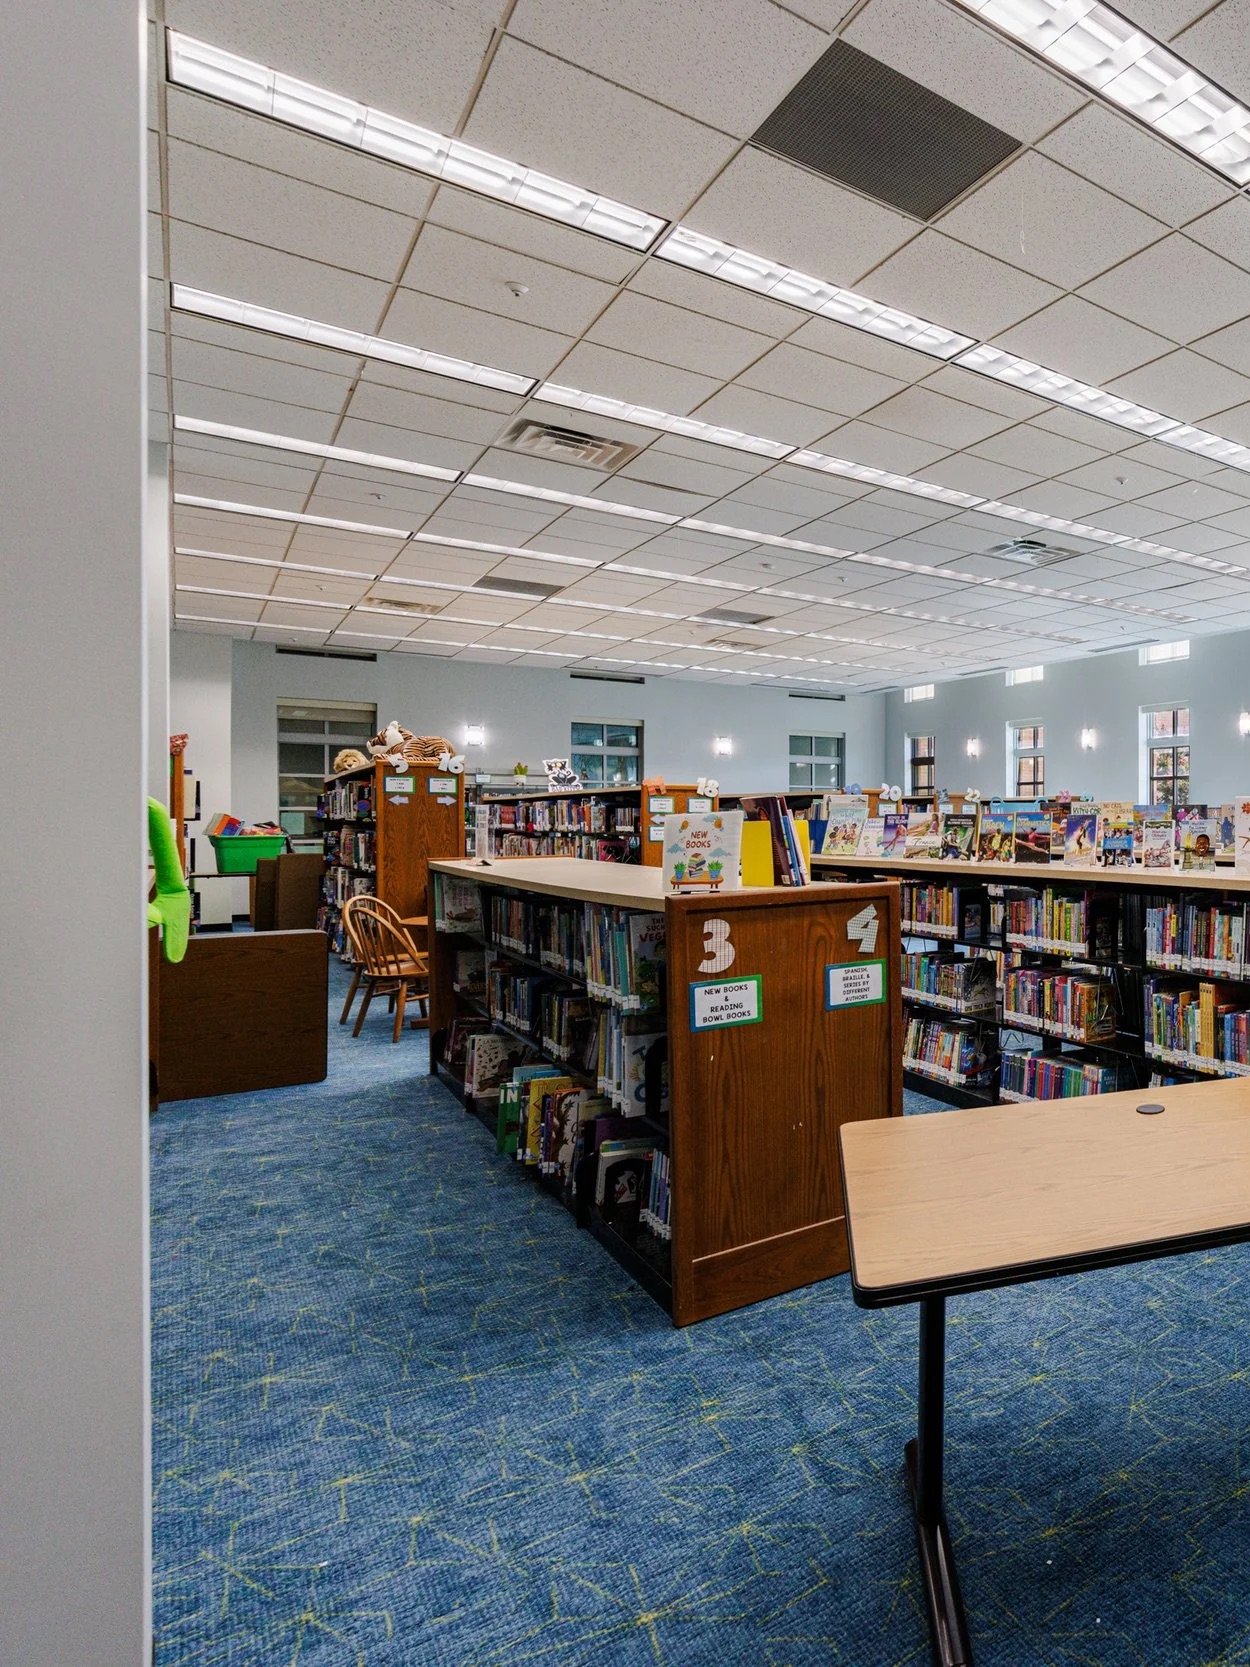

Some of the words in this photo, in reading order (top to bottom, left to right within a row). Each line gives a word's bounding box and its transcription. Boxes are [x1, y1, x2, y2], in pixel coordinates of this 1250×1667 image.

[438, 752, 465, 774] 16
[696, 777, 720, 798] 18
[879, 783, 902, 802] 20
[964, 787, 981, 803] 22
[690, 831, 709, 840] NEW
[685, 839, 711, 849] BOOKS
[846, 903, 880, 954] 4
[697, 918, 736, 974] 3
[704, 987, 721, 997] NEW
[723, 983, 749, 994] BOOKS
[842, 987, 870, 996] DIFFERENT
[843, 981, 862, 989] SERIES
[845, 994, 868, 1002] AUTHORS
[710, 1002, 744, 1014] READING
[702, 1012, 725, 1024] BOWL
[726, 1010, 751, 1022] BOOKS
